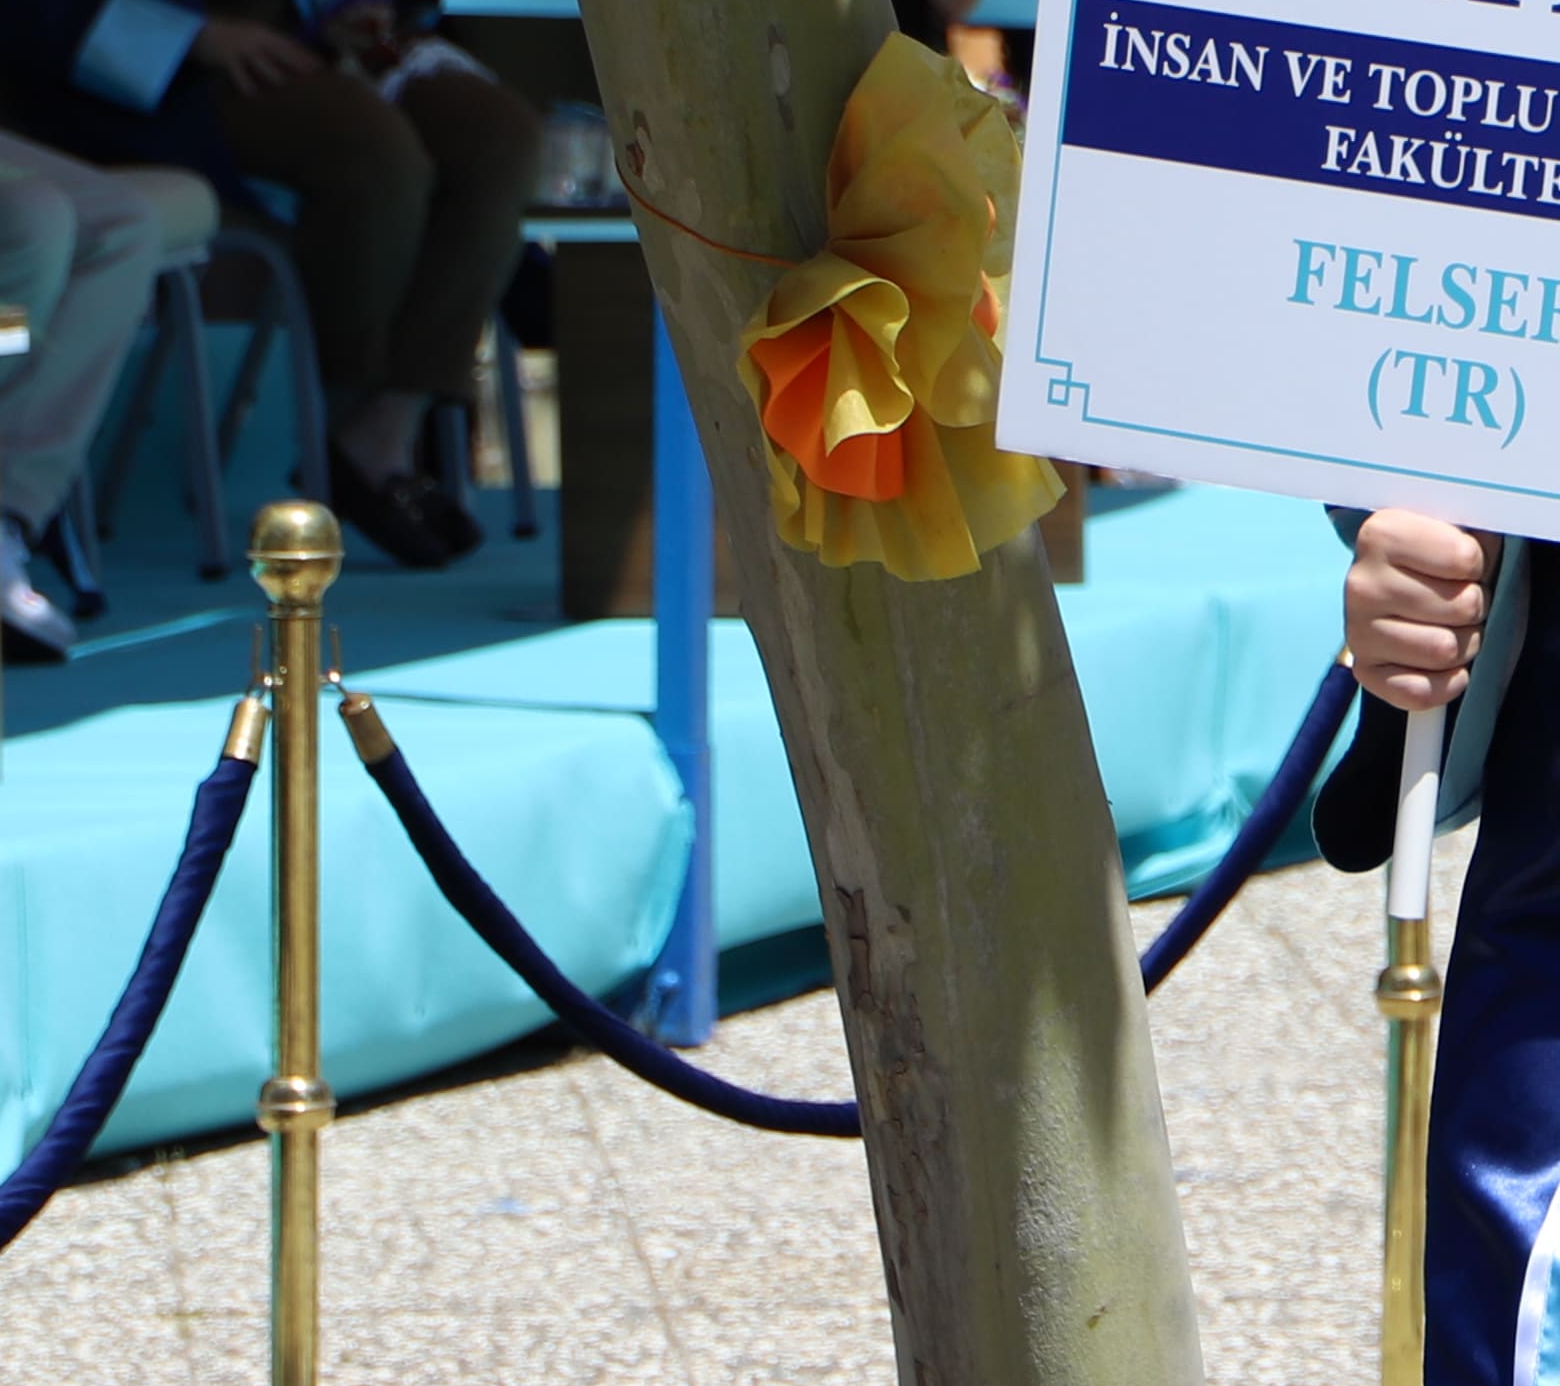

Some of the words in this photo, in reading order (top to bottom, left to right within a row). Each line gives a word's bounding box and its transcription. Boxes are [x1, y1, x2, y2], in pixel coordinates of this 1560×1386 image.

[1100, 11, 1269, 91] İNSAN
[1284, 50, 1352, 103] VE
[1368, 63, 1558, 133] TOPLU
[1368, 348, 1525, 448] (TR)
